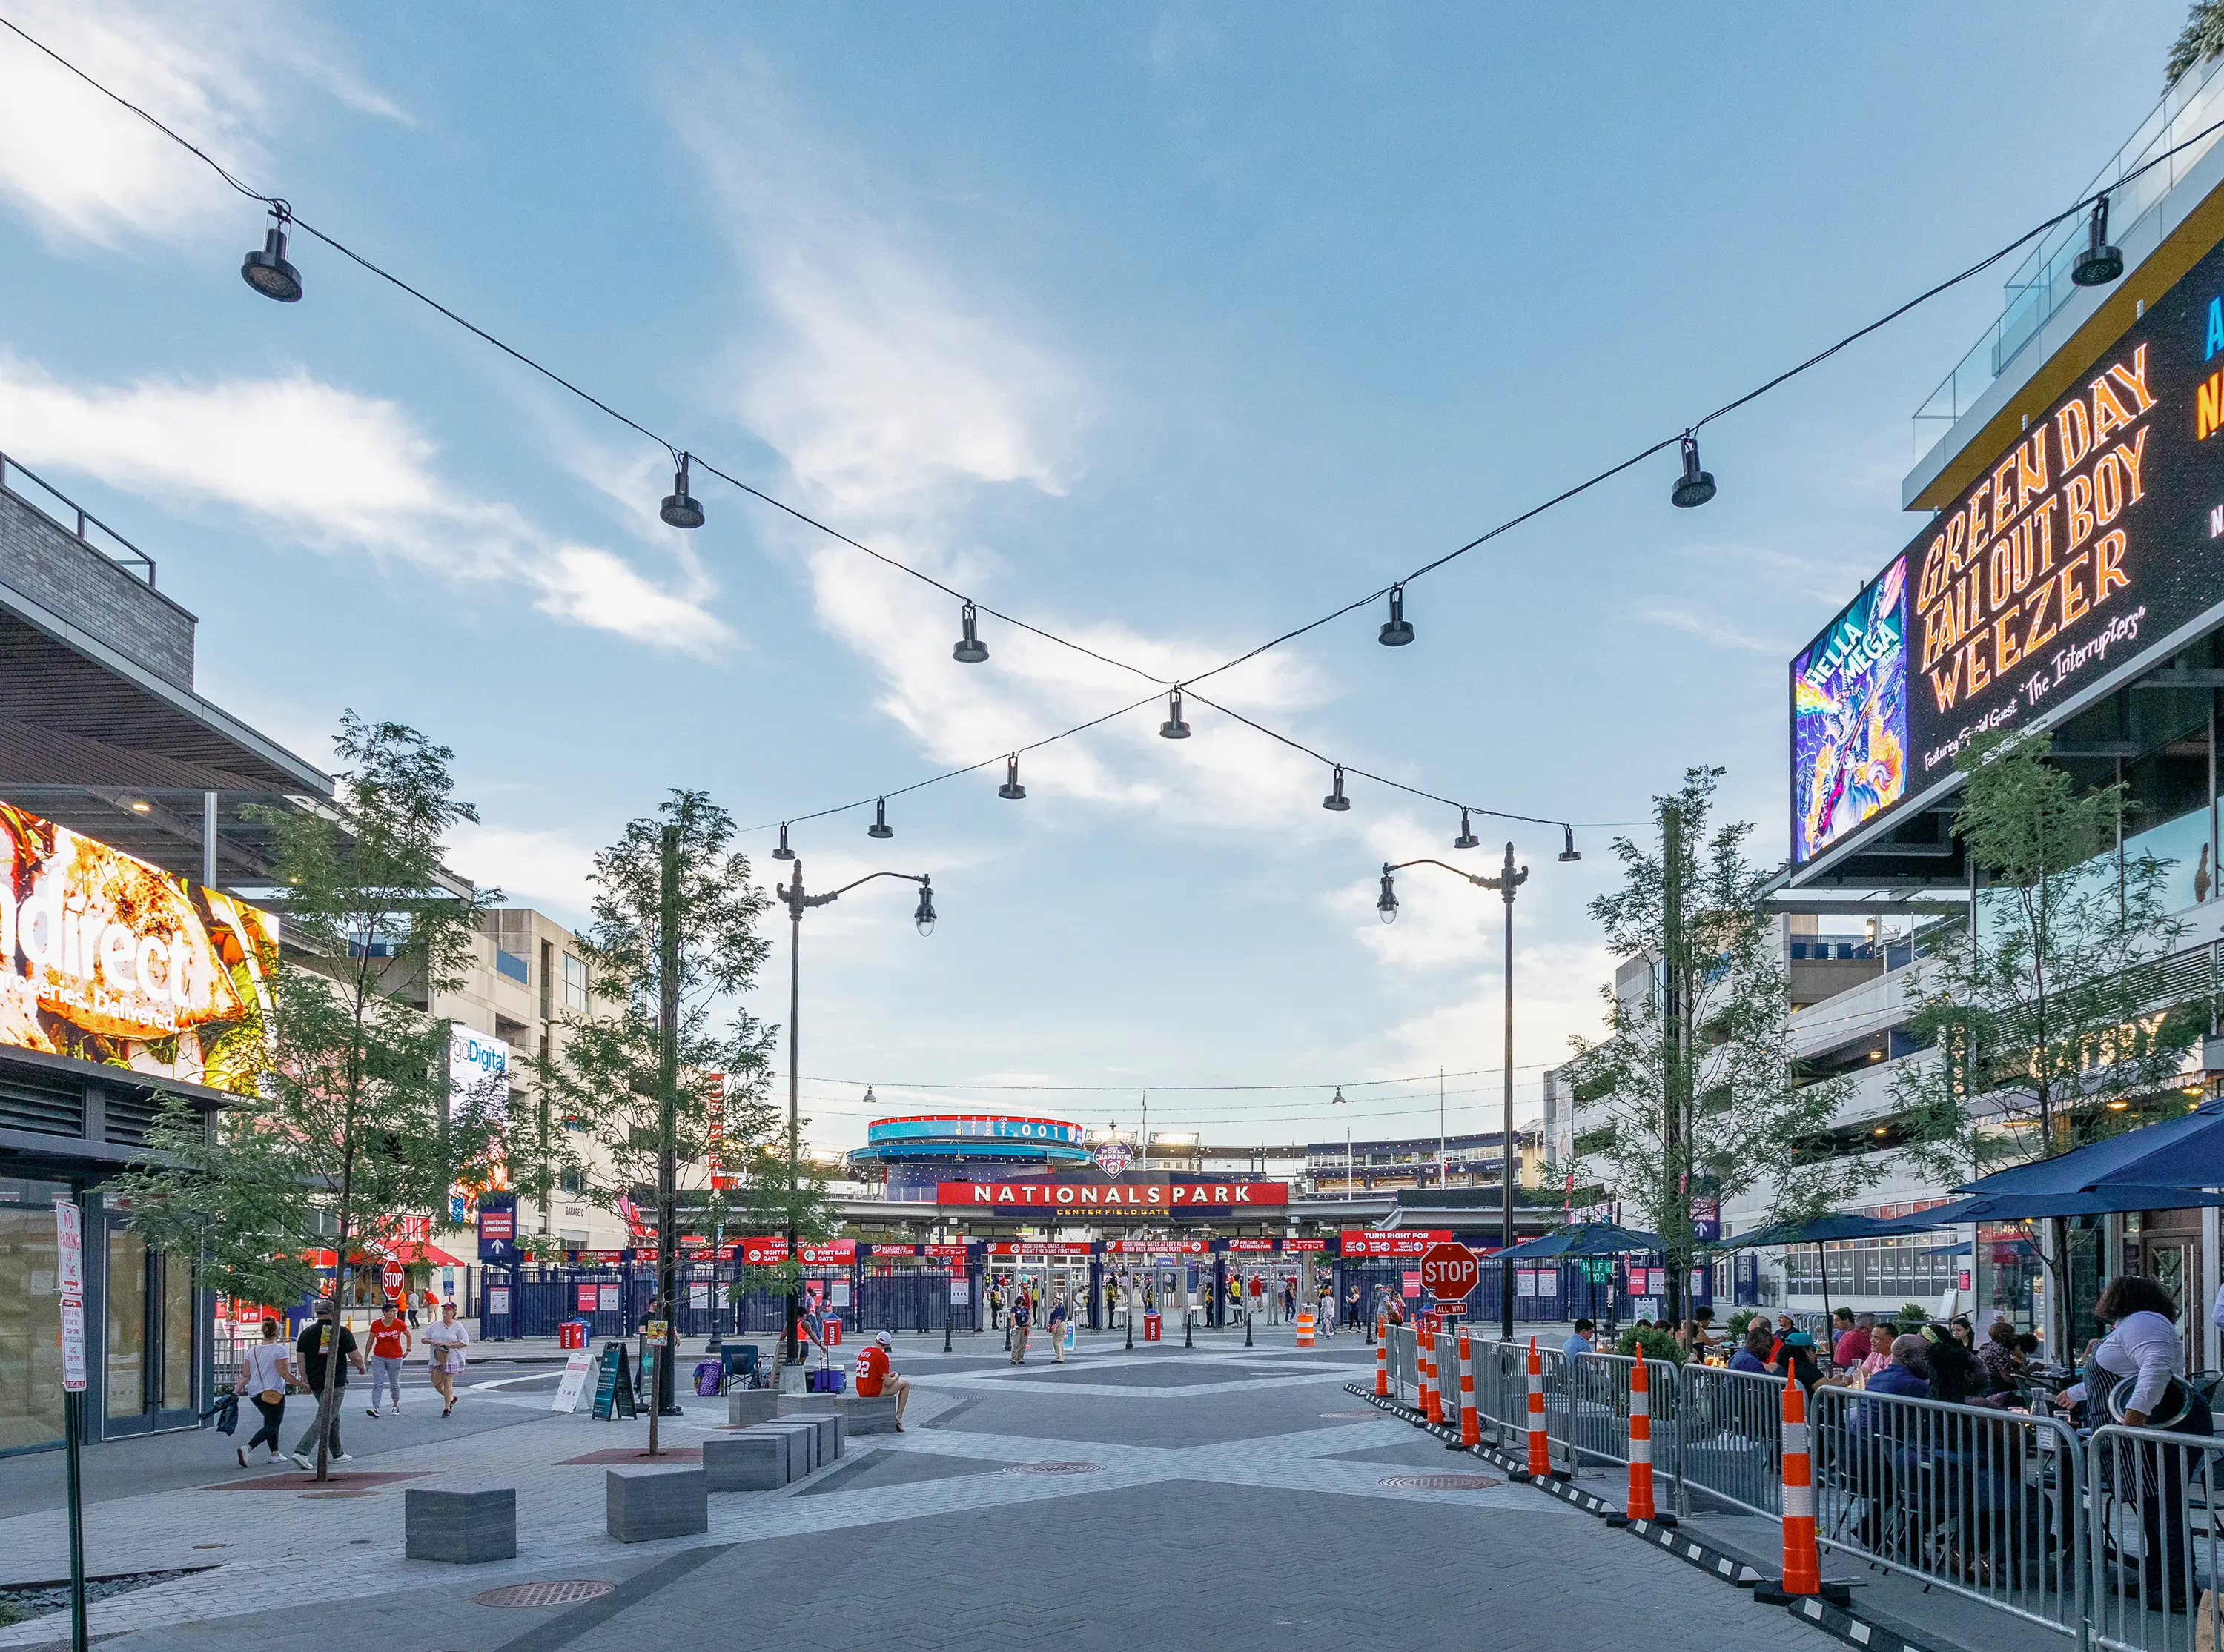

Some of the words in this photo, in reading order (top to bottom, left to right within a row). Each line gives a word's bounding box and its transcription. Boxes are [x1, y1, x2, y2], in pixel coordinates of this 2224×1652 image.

[2197, 366, 2224, 441] N
[1916, 423, 2049, 616] GREEN
[2055, 342, 2157, 477] DAY
[2211, 504, 2224, 538] N
[1920, 563, 1985, 675] FALL
[1990, 494, 2057, 611] OUT
[2062, 425, 2150, 555] BOY
[1929, 528, 2131, 714] WEEZER
[1806, 621, 1864, 690] HELLA
[1838, 620, 1900, 681] MEGA
[1884, 643, 1903, 662] TOUR
[1924, 738, 1959, 772] Featuring
[1959, 714, 1988, 746] Spcial
[1990, 698, 2018, 728] Guest
[94, 987, 180, 1033] Delivered.
[454, 1039, 506, 1072] goDigital
[1022, 1124, 1031, 1136] 0
[1038, 1125, 1047, 1138] 0
[1053, 1127, 1059, 1138] 1
[974, 1185, 1161, 1204] NATIONALS
[1173, 1186, 1251, 1202] PARK
[64, 1211, 73, 1229] NO
[566, 1206, 578, 1216] GARAGE
[580, 1209, 584, 1217] C
[384, 1272, 403, 1287] STOP
[1425, 1261, 1475, 1282] STOP
[1583, 1262, 1603, 1271] HLF
[1587, 1273, 1605, 1281] 100
[855, 1360, 870, 1379] 22
